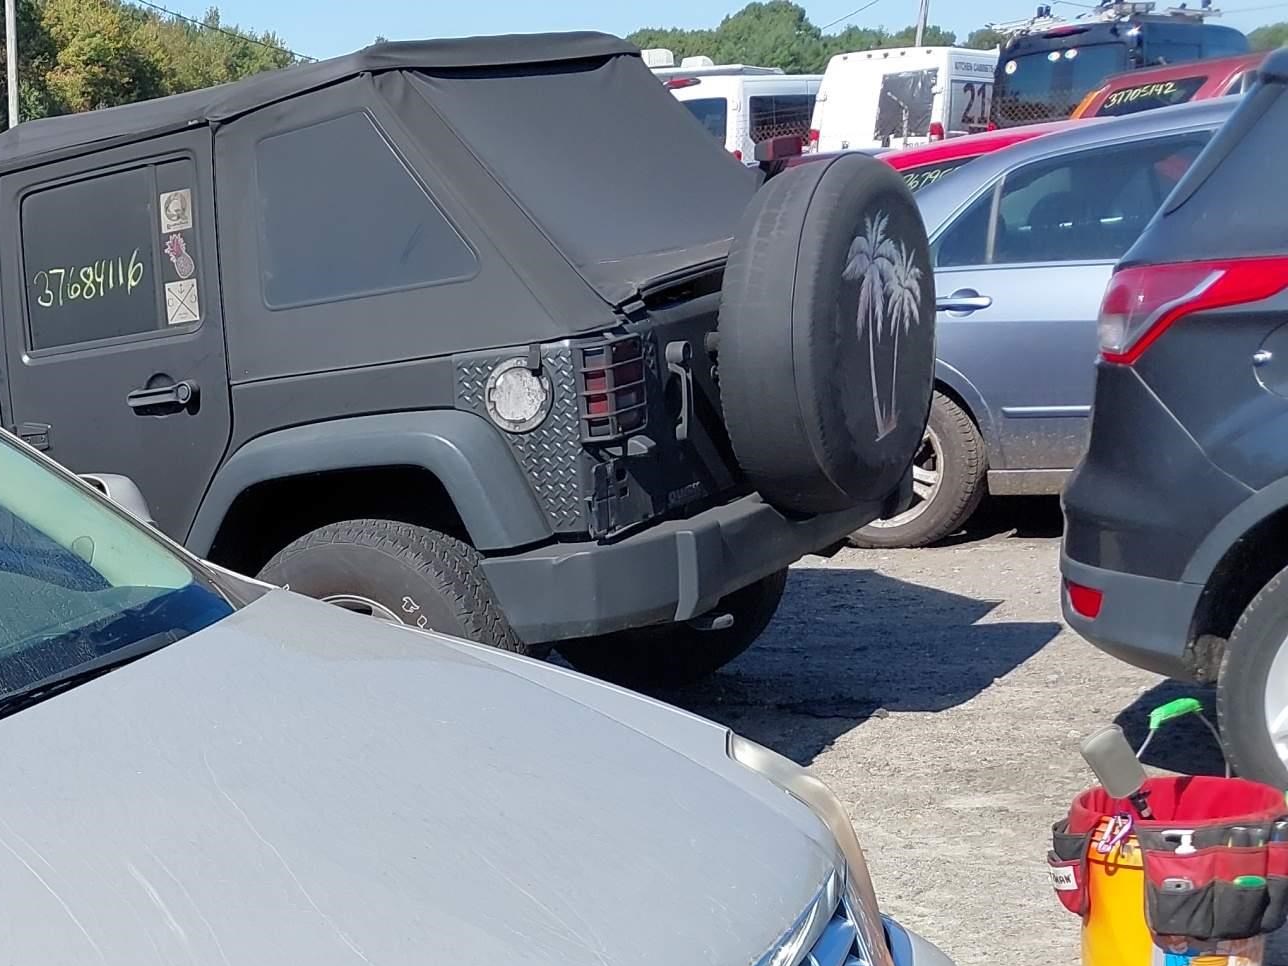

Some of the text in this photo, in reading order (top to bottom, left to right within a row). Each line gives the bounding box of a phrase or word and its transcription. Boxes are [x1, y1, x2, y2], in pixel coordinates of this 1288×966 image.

[961, 82, 988, 124] 21
[1104, 82, 1177, 109] 37705142
[33, 247, 144, 307] 37684116
